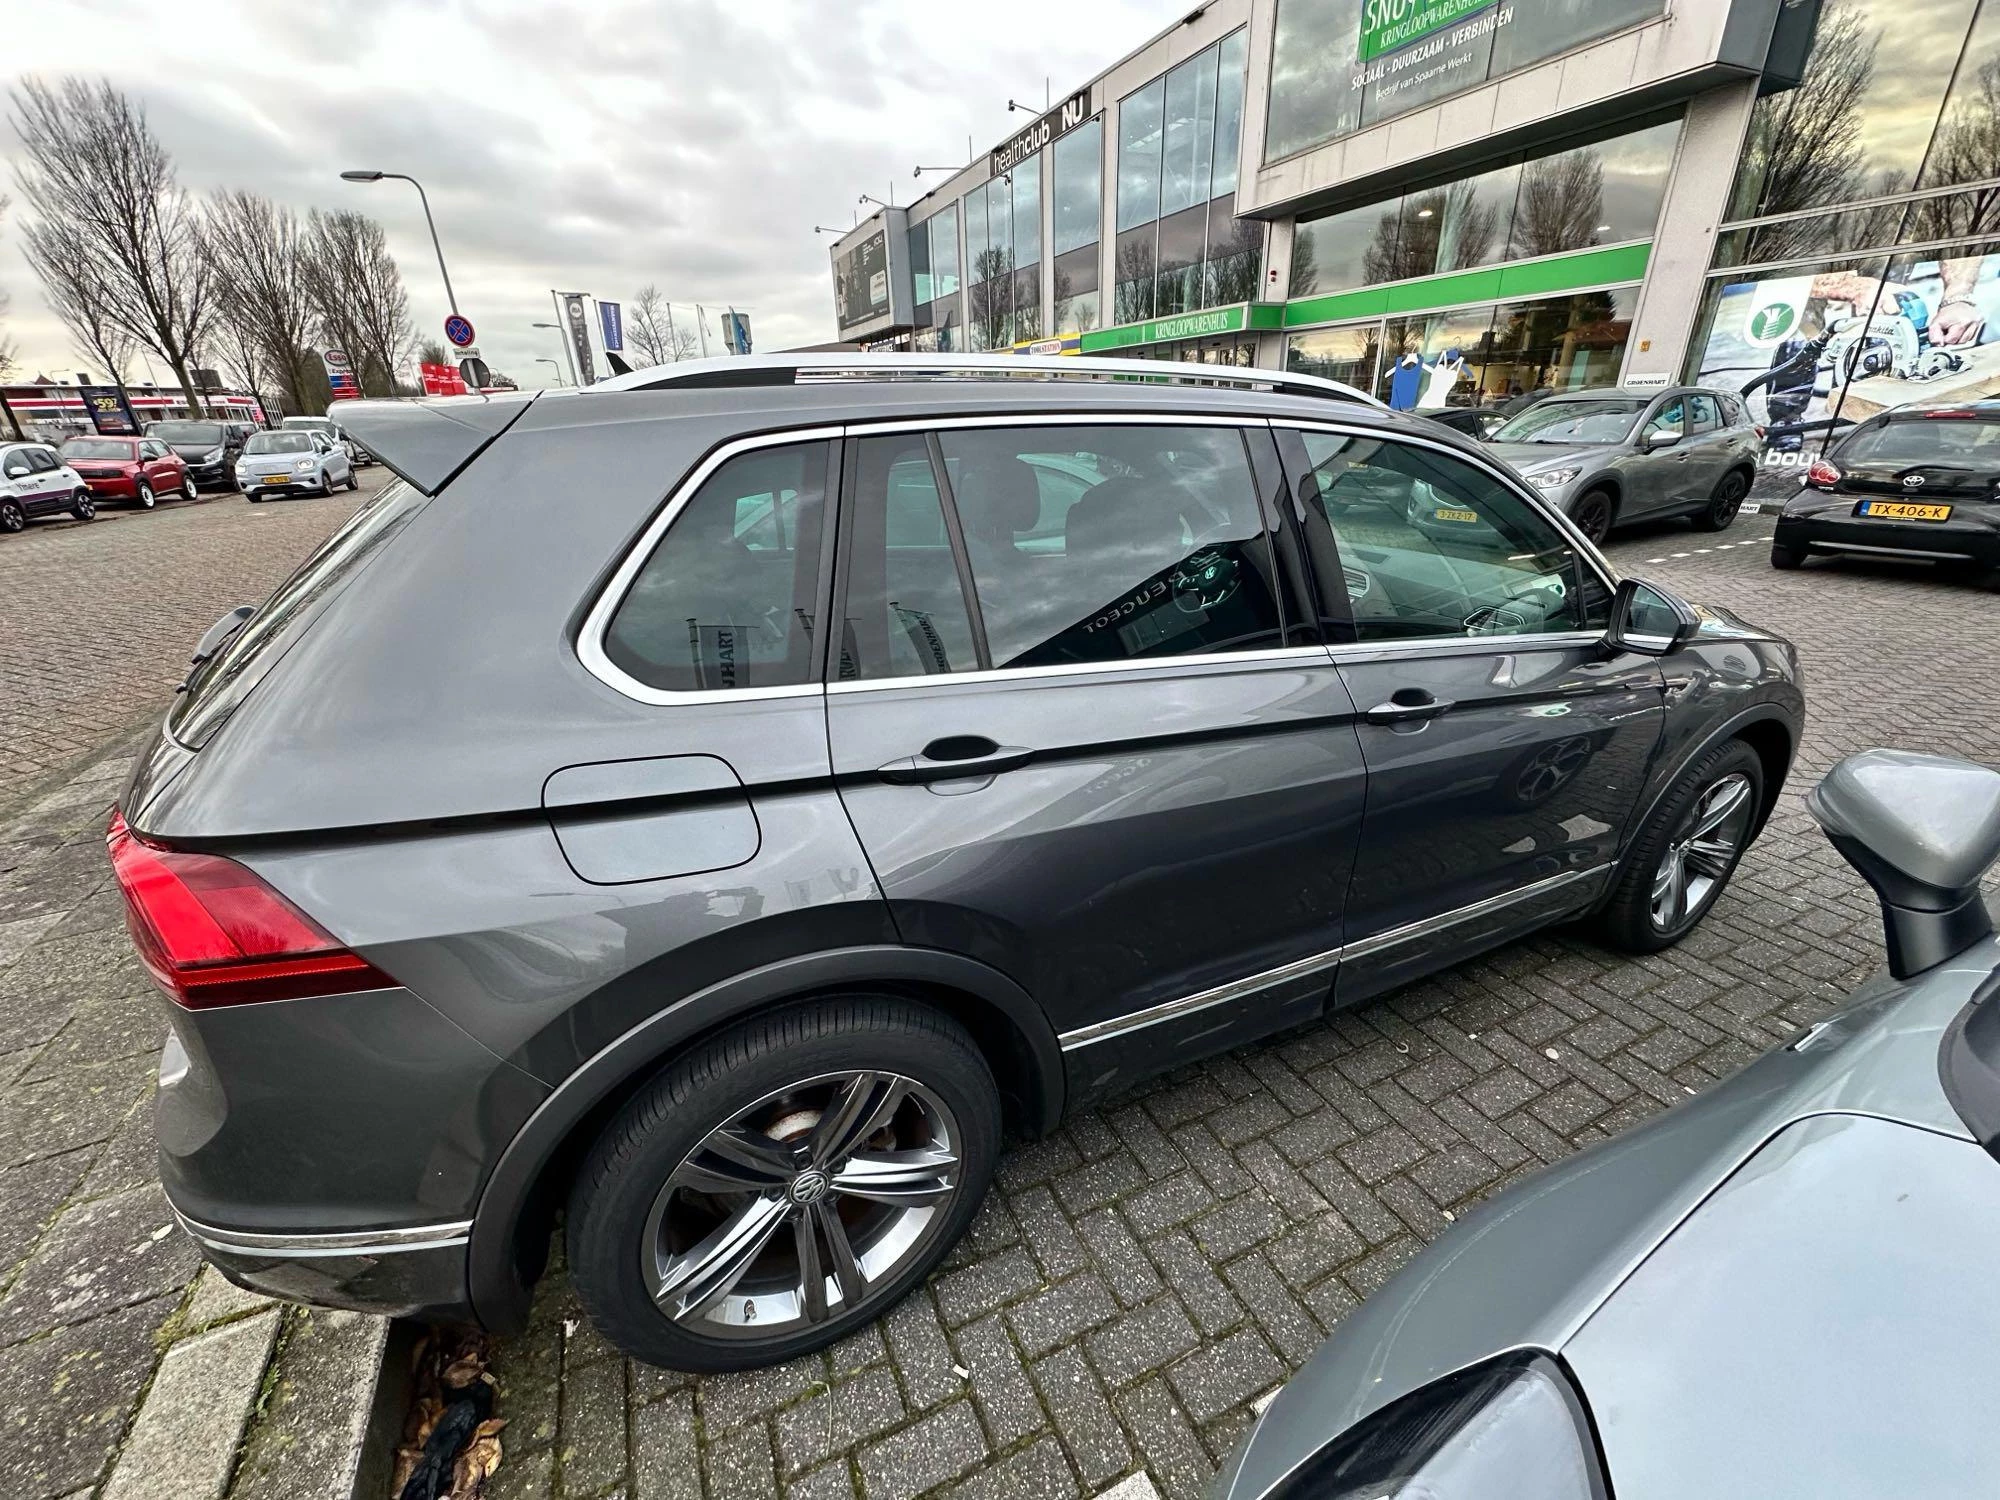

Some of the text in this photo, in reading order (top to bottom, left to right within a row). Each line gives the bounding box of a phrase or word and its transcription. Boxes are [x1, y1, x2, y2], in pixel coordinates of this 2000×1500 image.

[1351, 62, 1385, 91] SOCIAAL
[1392, 38, 1445, 74] DUURZAAM
[1452, 7, 1514, 48] VERBINDEN
[1376, 52, 1472, 100] Bedrijf van Spaarne Werkt
[994, 96, 1083, 174] healthclub NU
[1155, 312, 1228, 339] KRINGLOOPWARENHUIS
[1874, 504, 1943, 518] TX-406-K
